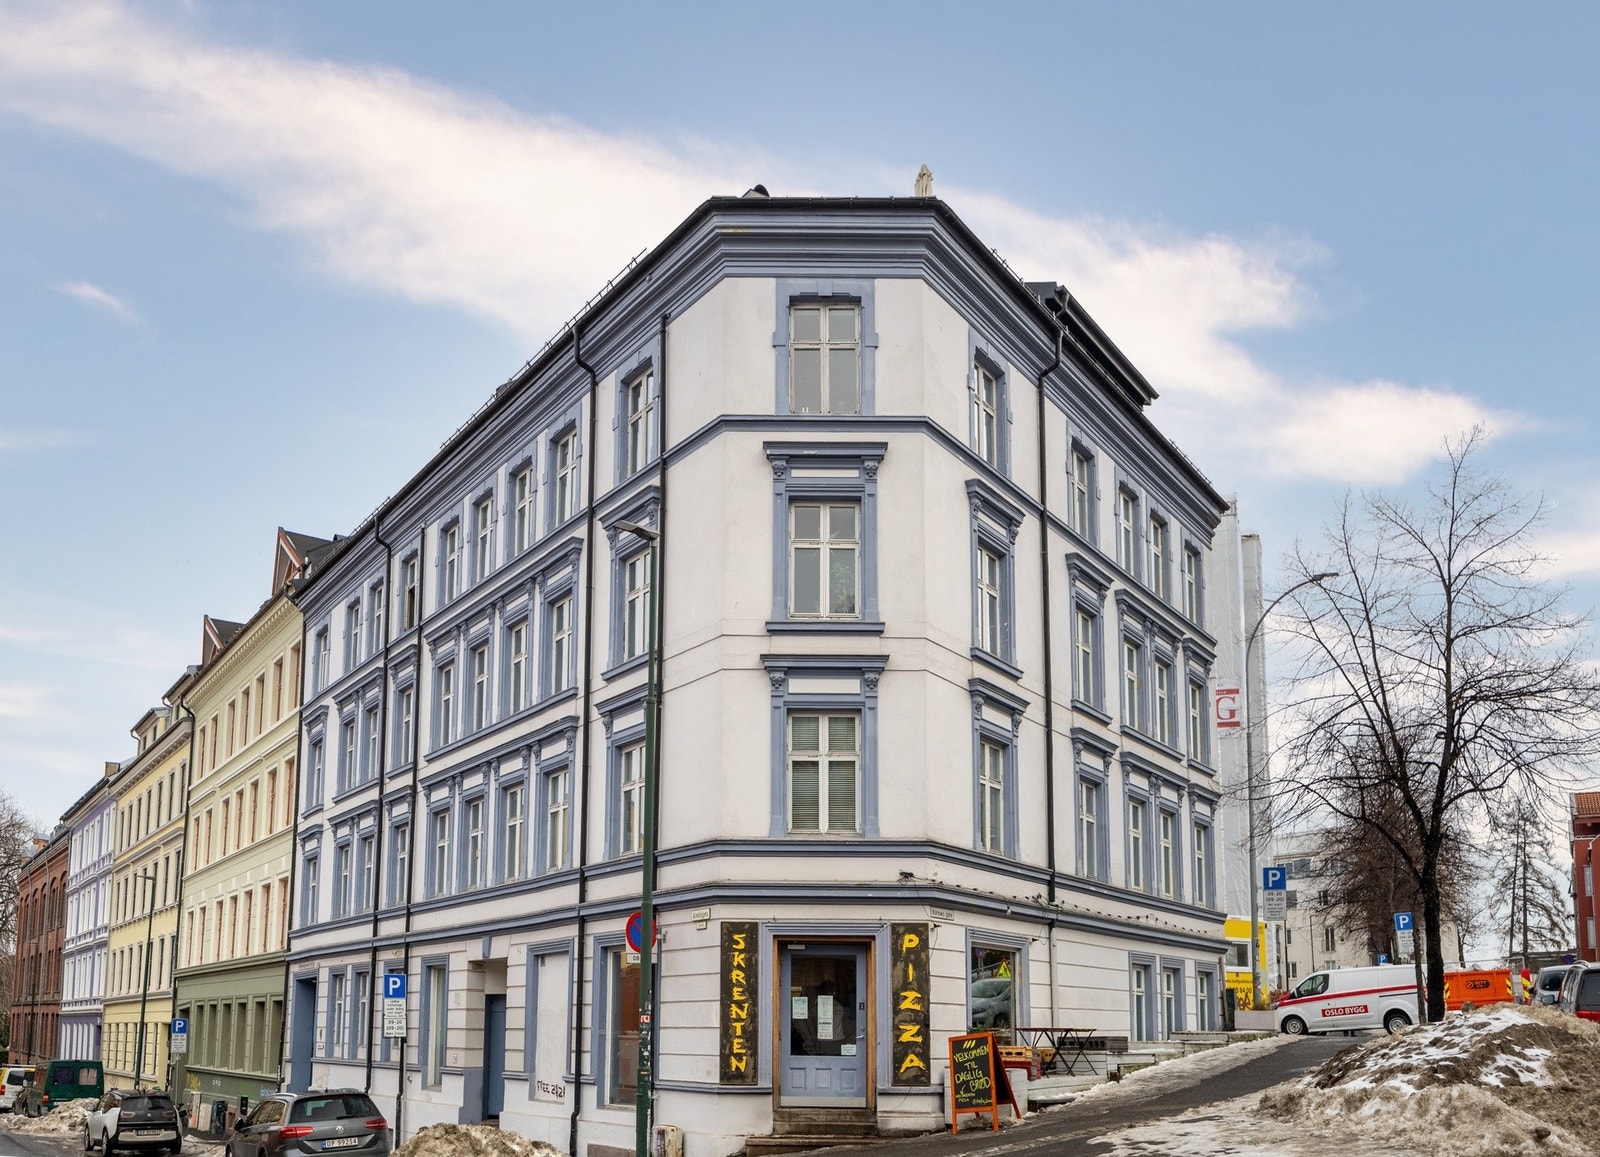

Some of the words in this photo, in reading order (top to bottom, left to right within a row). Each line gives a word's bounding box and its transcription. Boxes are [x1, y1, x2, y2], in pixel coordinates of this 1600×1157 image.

[1268, 870, 1280, 888] P
[1400, 915, 1409, 928] P
[389, 977, 401, 996] P
[730, 933, 748, 1072] SKRENTEN
[898, 933, 926, 1074] PIZZA
[1344, 1006, 1365, 1014] BYGG
[954, 1044, 989, 1063] VELKOMMEN
[964, 1061, 978, 1070] TIL
[955, 1069, 984, 1084] DAGLIG
